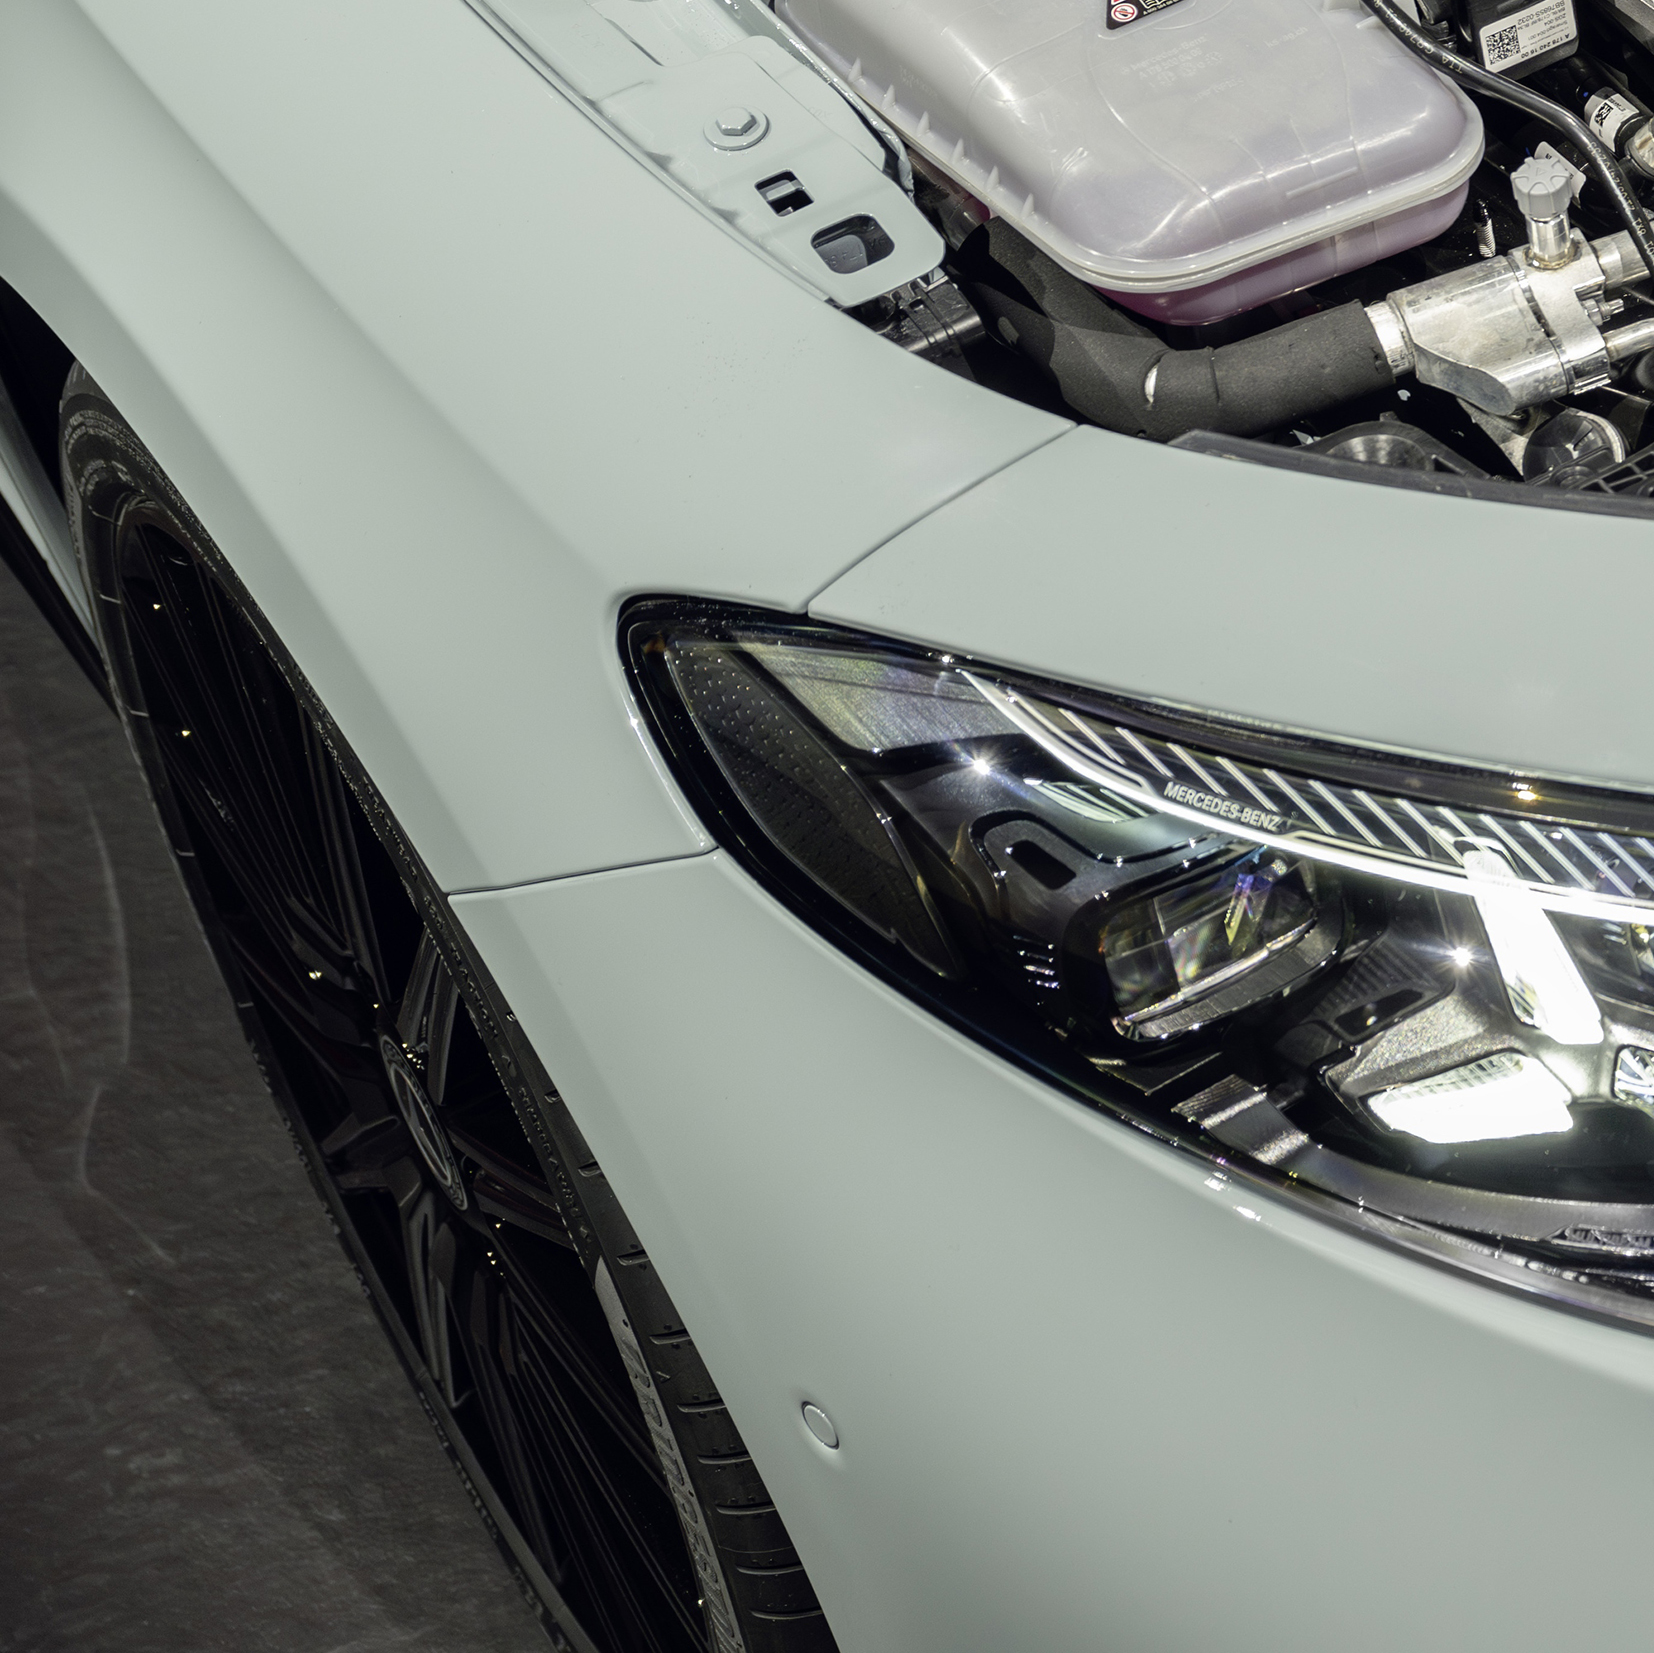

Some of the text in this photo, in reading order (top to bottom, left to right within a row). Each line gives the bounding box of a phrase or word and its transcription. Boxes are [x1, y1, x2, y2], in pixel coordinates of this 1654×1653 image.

[1551, 36, 1563, 45] 178
[1539, 42, 1552, 51] 240
[1521, 51, 1530, 59] 00
[1441, 55, 1463, 74] TIA
[1163, 780, 1283, 833] MERCEDES-BENZ
